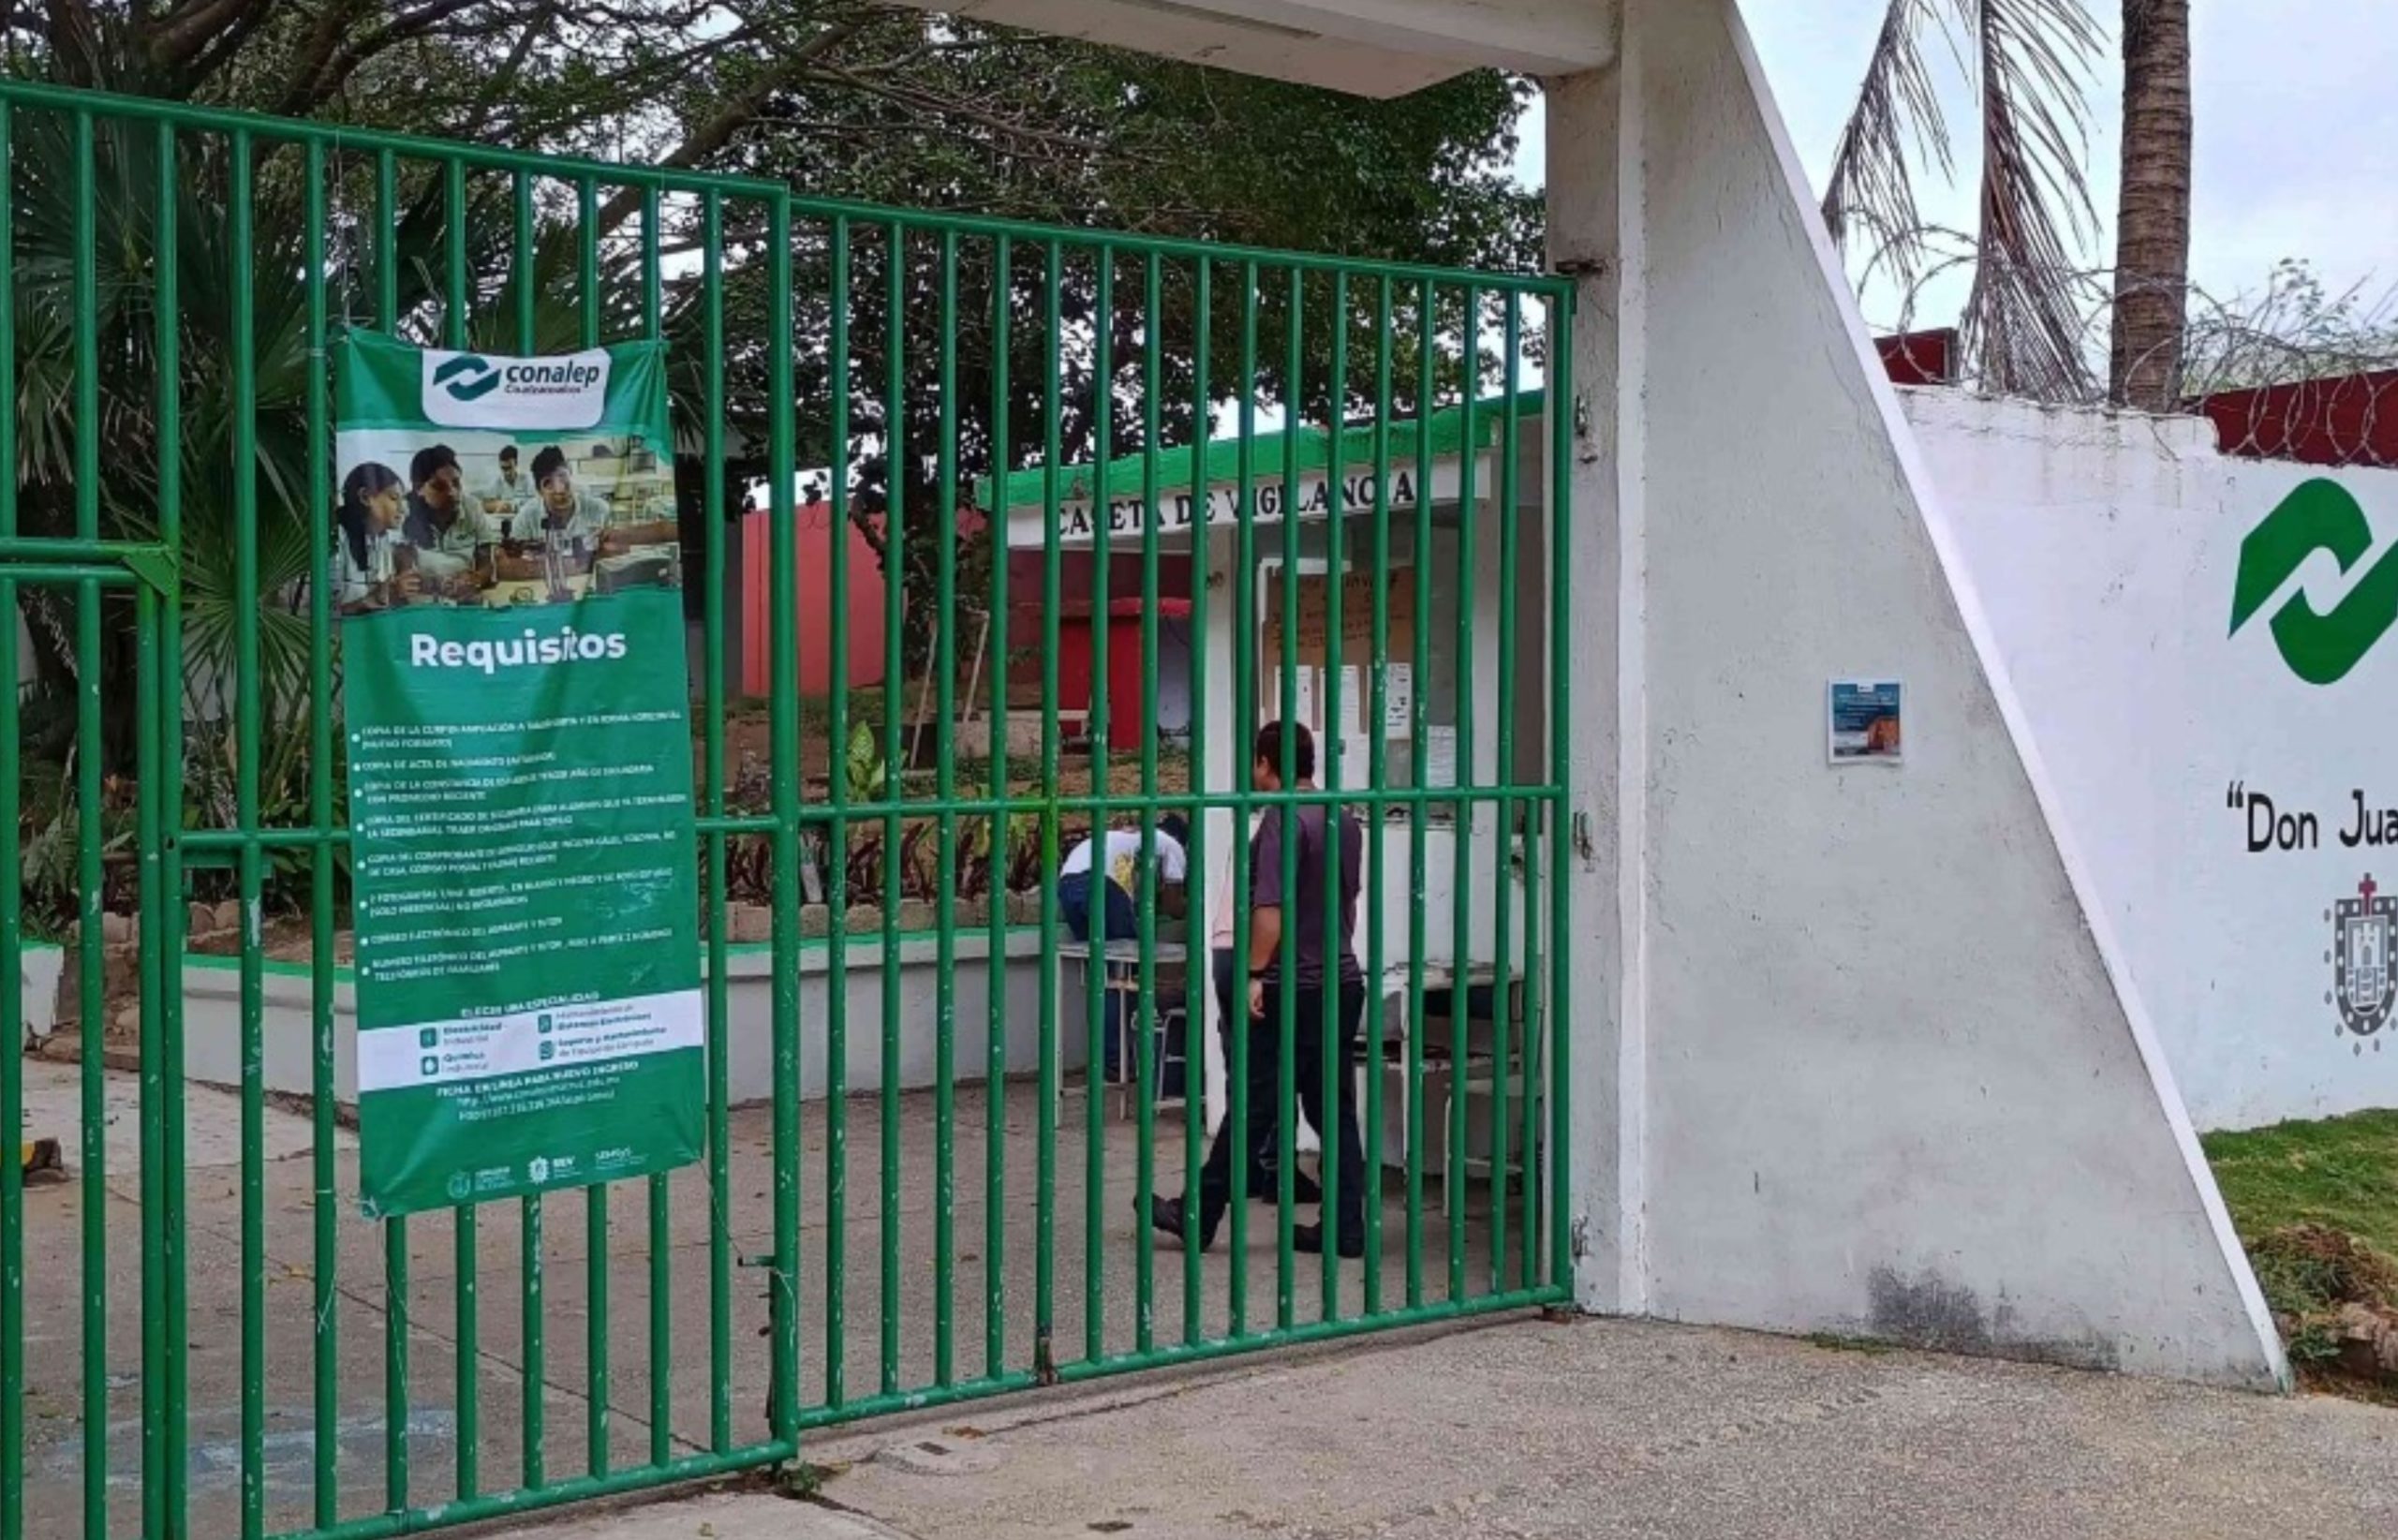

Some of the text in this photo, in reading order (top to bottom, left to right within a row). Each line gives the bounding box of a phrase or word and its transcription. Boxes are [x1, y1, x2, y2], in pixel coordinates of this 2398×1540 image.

[506, 360, 600, 388] conalep
[1058, 498, 1166, 535] CAET
[1225, 471, 1414, 520] VIGIANCA
[410, 625, 628, 674] Requisitos
[2339, 788, 2398, 848] Jua
